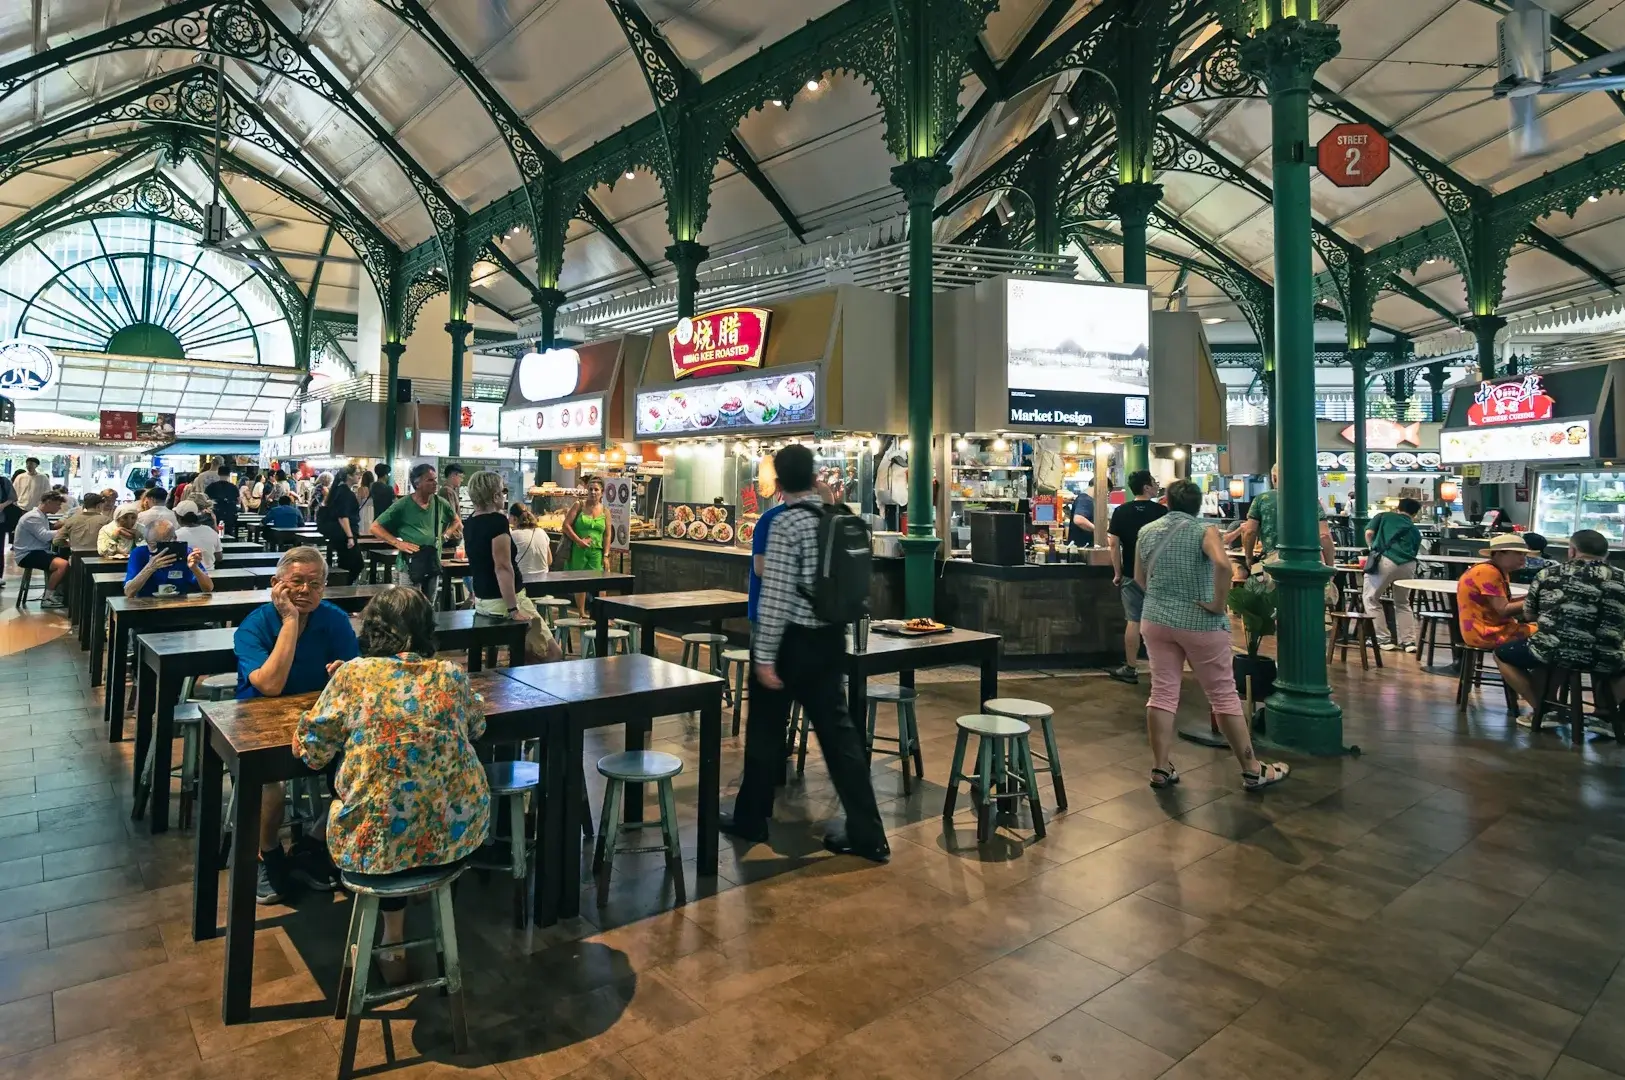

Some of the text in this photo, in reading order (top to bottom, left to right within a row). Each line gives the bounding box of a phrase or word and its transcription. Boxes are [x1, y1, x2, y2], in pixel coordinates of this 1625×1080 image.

[1337, 134, 1368, 145] STREET
[1345, 147, 1361, 176] 2
[693, 312, 741, 352] 烧腊
[701, 350, 715, 361] KEE
[715, 344, 749, 359] ROASTED
[1011, 408, 1093, 426] Market Design
[1482, 411, 1536, 423] CHINESE CUISINE
